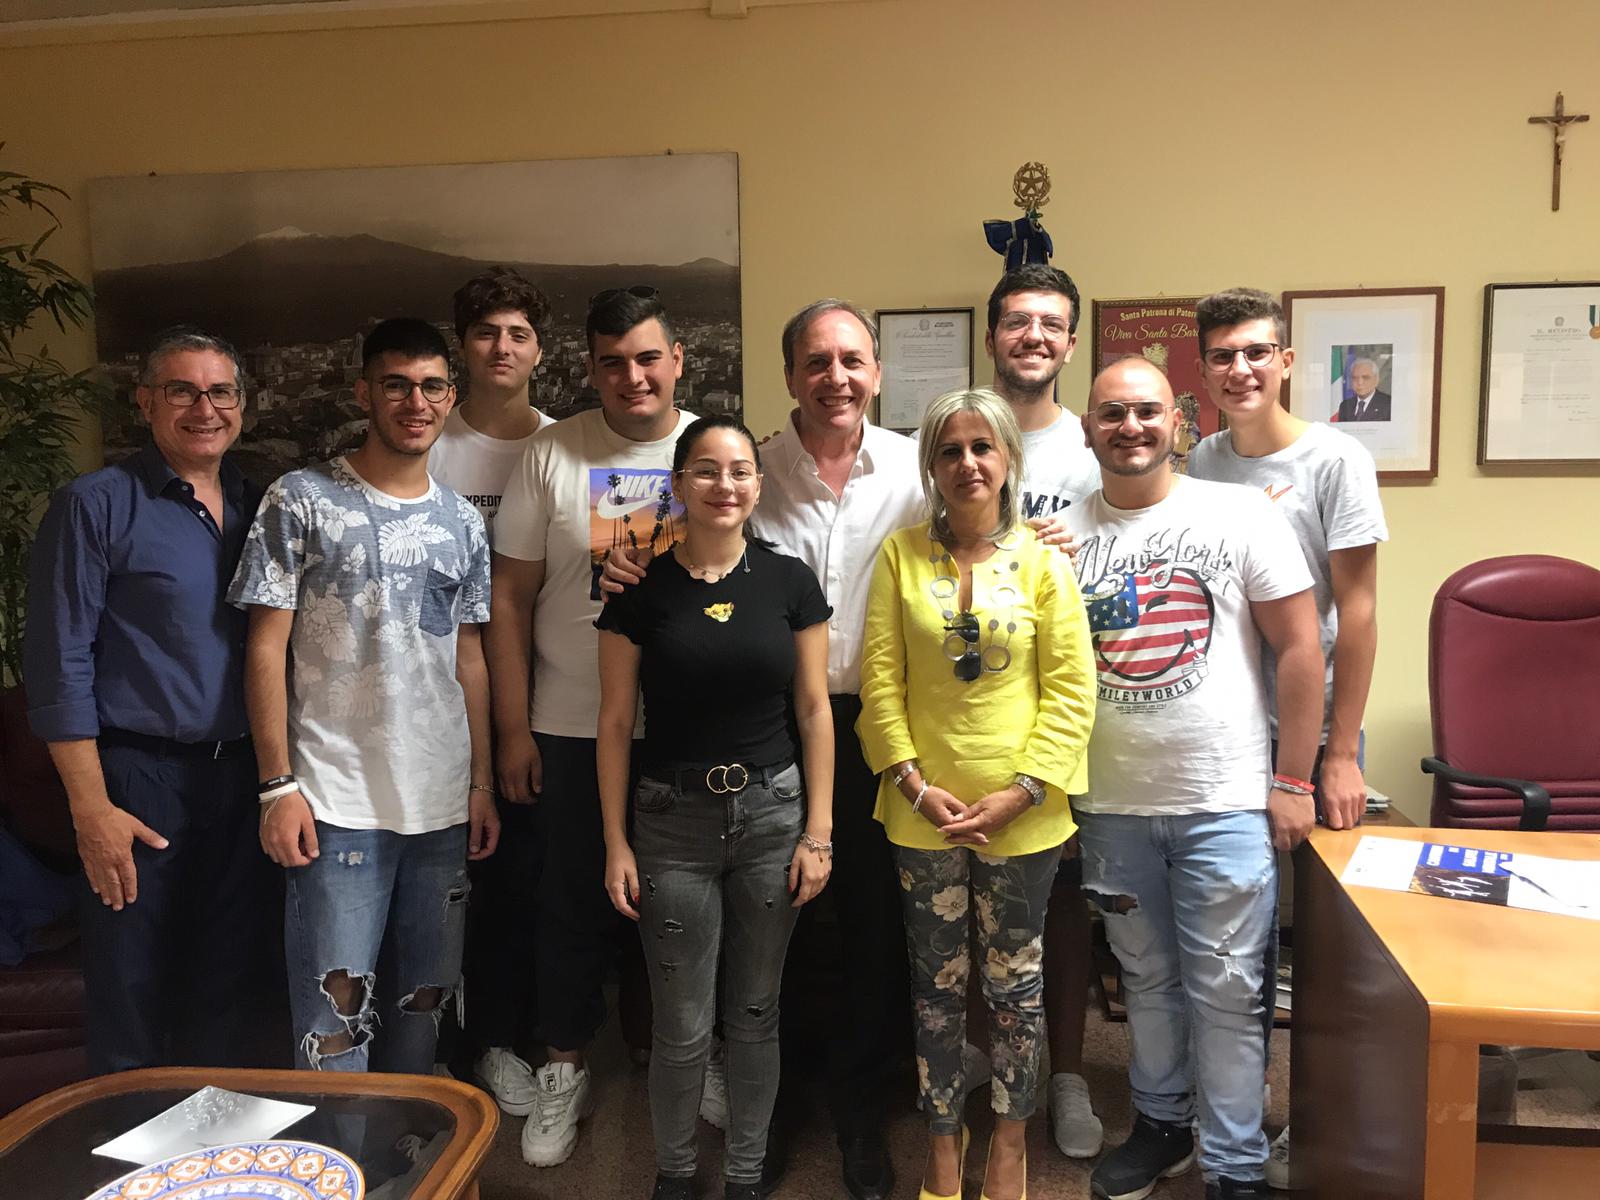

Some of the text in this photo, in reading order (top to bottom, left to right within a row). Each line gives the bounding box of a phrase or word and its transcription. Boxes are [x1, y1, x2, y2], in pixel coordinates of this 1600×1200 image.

[1120, 311, 1140, 322] Santa
[1141, 307, 1167, 318] Patrona
[1168, 307, 1175, 317] di
[1104, 323, 1132, 341] Viva
[1135, 323, 1168, 340] Santa
[610, 475, 666, 498] NIKE
[1076, 528, 1232, 600] New York
[1097, 678, 1193, 702] MILEYWORLD
